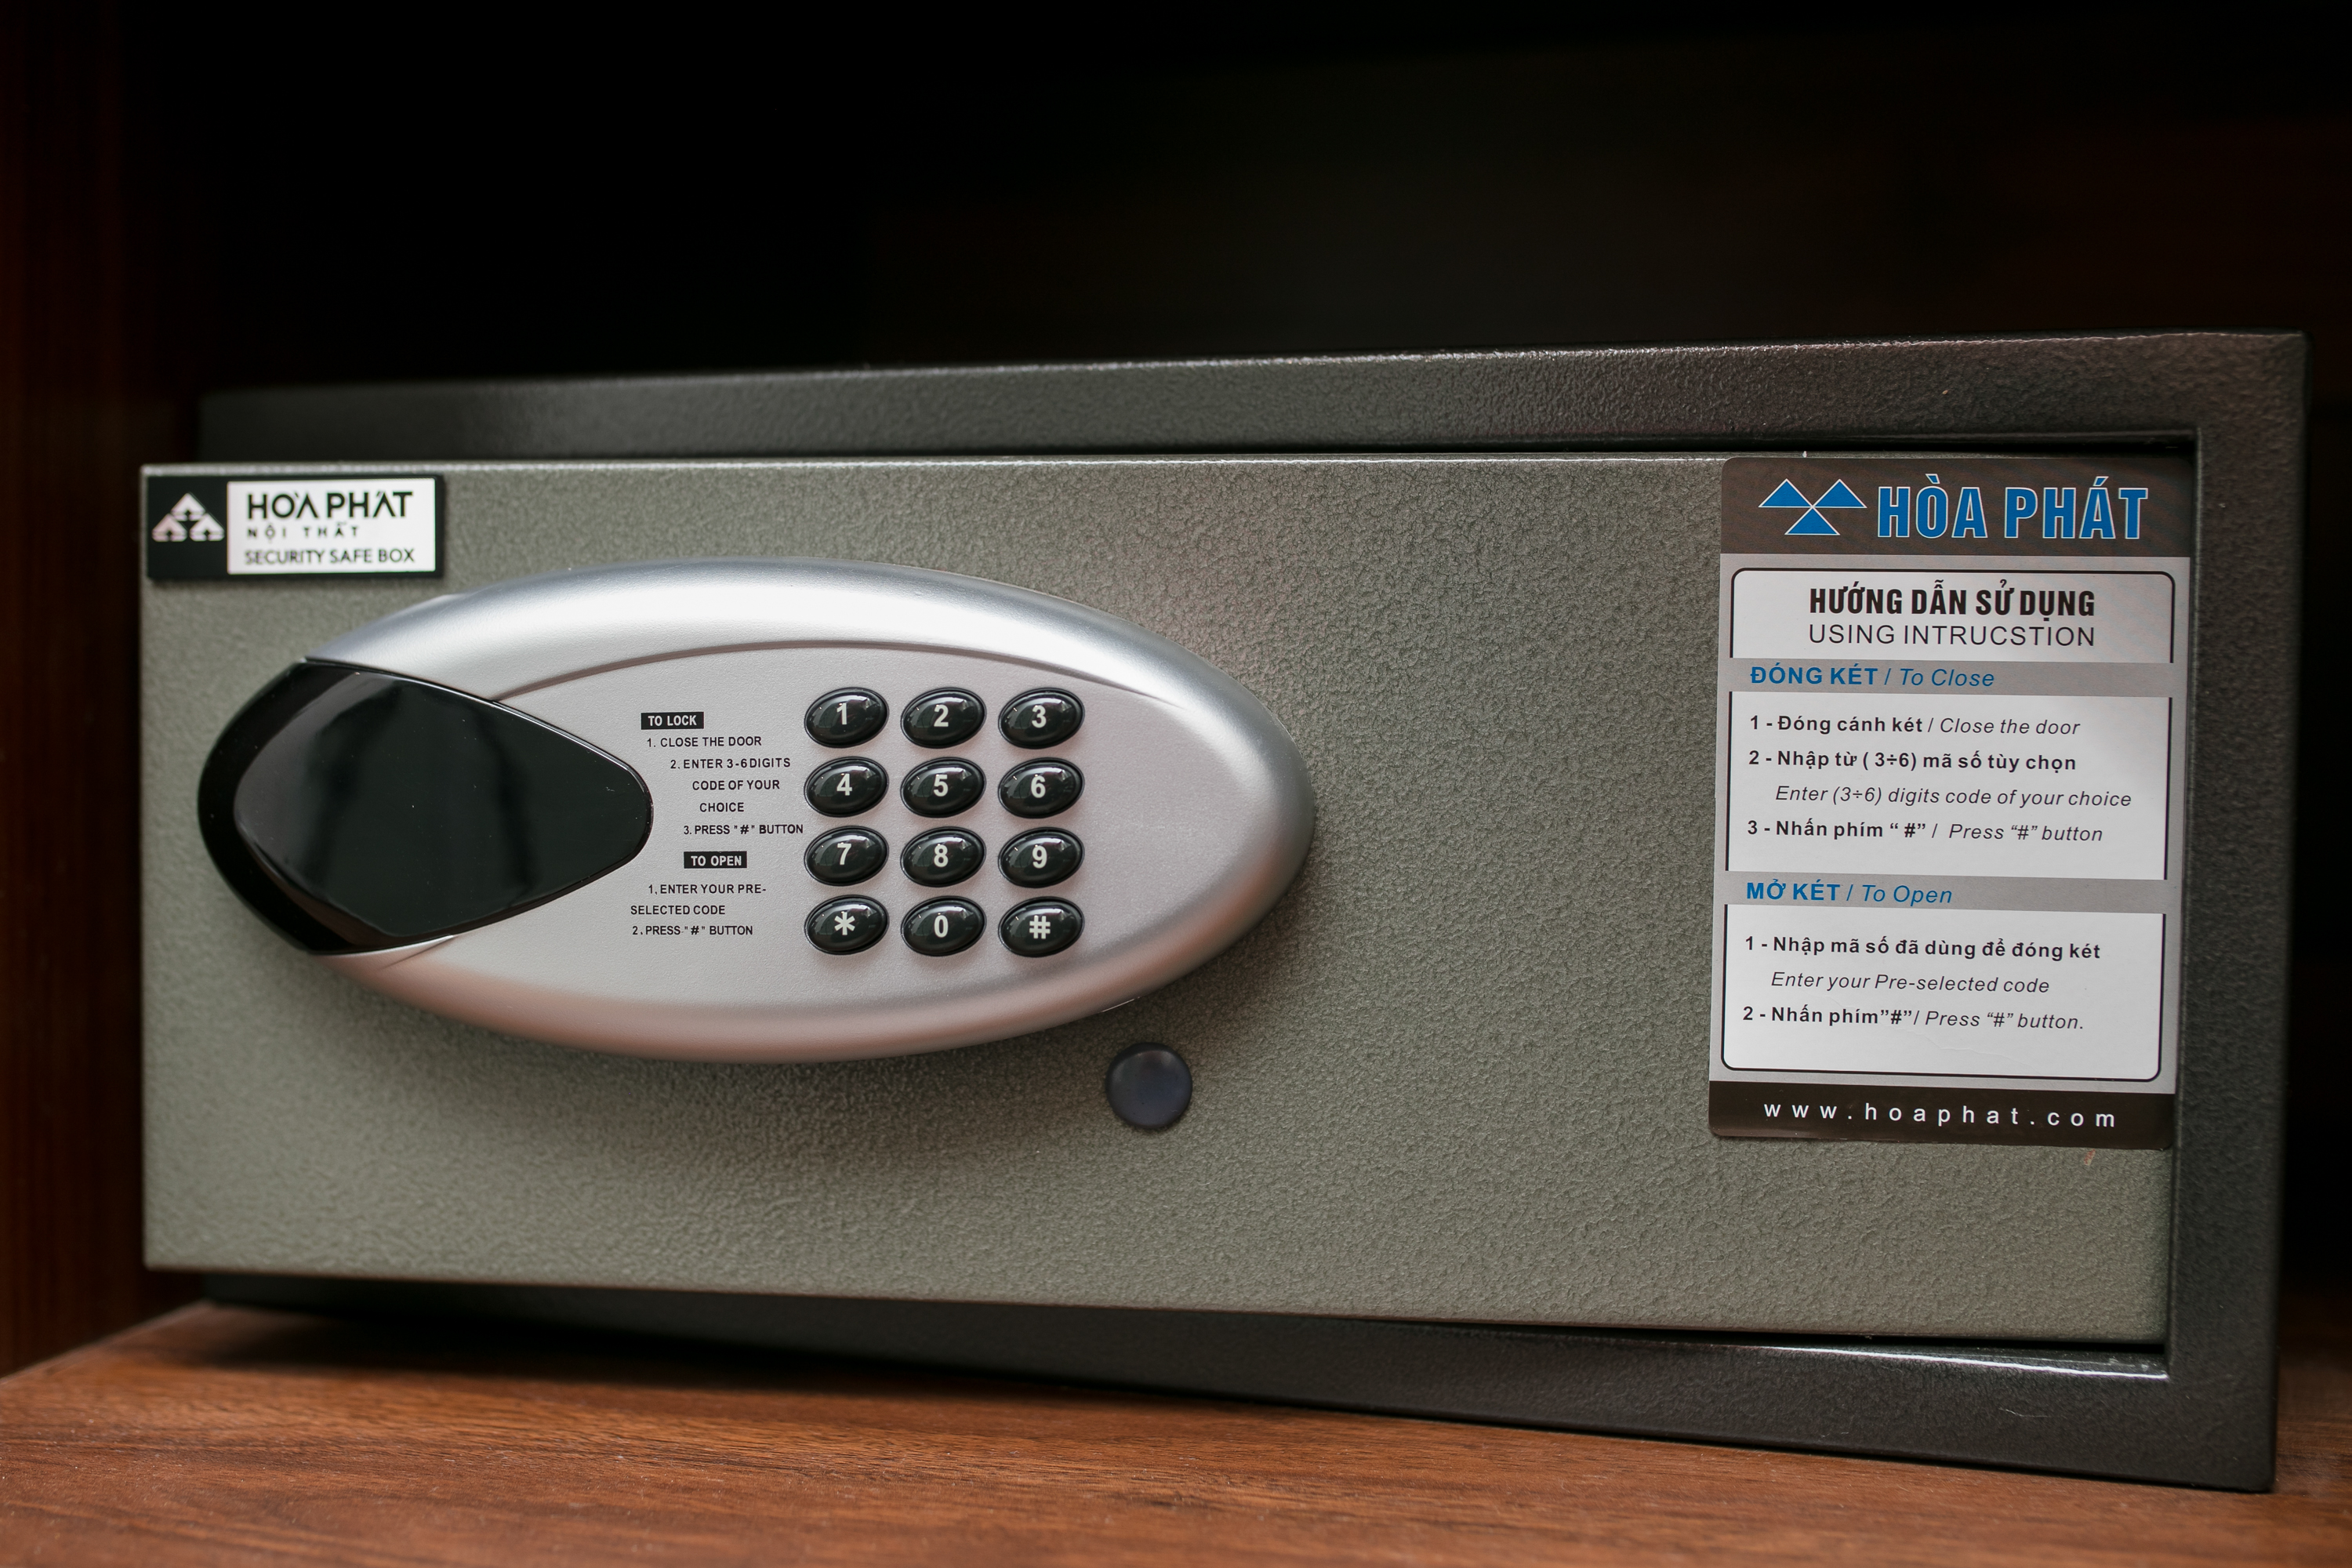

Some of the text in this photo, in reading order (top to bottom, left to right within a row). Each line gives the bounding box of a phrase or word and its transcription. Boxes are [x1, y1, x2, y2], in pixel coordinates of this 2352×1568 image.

[327, 492, 412, 517] PHÁT
[1878, 474, 2148, 539] HÒA PHÁT
[245, 549, 414, 564] SECURITY SAFE BOX
[1810, 579, 2094, 621] HƯỚNG DẪN SỬ DỤNG
[1810, 625, 2094, 646] USING INTRUCSTION
[1751, 662, 1822, 684] ĐÓNG
[1831, 663, 1878, 684] KÉT
[1900, 669, 1923, 685] To
[1932, 669, 1994, 686] Close
[648, 715, 696, 726] TO LOCK
[837, 702, 1047, 728] 1 2 3
[1751, 716, 1757, 729] 1
[1777, 716, 1830, 734] Đóng
[1838, 717, 1885, 731] cánh
[1893, 717, 1922, 732] két
[1940, 718, 1994, 733] Close
[2001, 719, 2029, 734] the
[2036, 720, 2080, 734] door
[661, 738, 698, 747] CLOSE
[702, 737, 724, 746] THE
[729, 736, 761, 746] DOOR
[684, 759, 722, 768] ENTER
[1749, 750, 1759, 764] 2
[1778, 751, 1828, 769] Nhập
[1835, 752, 1857, 766] từ
[1924, 753, 1951, 768] mã
[1958, 750, 1981, 768] số
[1988, 754, 2020, 772] tùy
[2026, 755, 2075, 773] chọn
[693, 780, 779, 790] CODE OF YOUR
[837, 774, 1046, 798] 4 5 6
[700, 803, 744, 812] CHOICE
[1776, 786, 1828, 800] Enter
[1889, 788, 1939, 806] digits
[1946, 789, 1991, 804] code
[1998, 789, 2017, 804] of
[2020, 794, 2063, 808] your
[2069, 791, 2131, 806] choice
[695, 825, 730, 834] PRESS
[760, 824, 803, 833] BUTTON
[1748, 820, 1757, 834] 3
[1777, 818, 1827, 836] Nhấn
[1835, 822, 1882, 840] phím
[1949, 824, 2004, 839] Press
[2042, 826, 2102, 840] button
[691, 855, 741, 866] TO OPEN
[837, 843, 1047, 869] 7 8 9
[661, 884, 697, 894] ENTER
[701, 884, 734, 894] YOUR
[739, 884, 766, 893] PRE-
[1748, 879, 1786, 899] MỞ
[1793, 879, 1840, 900] KÉT
[1863, 885, 1885, 902] To
[1893, 885, 1951, 906] Open
[631, 906, 725, 914] SELECTED CODE
[646, 926, 681, 935] PRESS
[710, 926, 753, 935] BUTTON
[934, 914, 949, 938] 0
[1746, 936, 1752, 950] 1
[1774, 937, 1824, 955] Nhập
[1831, 939, 1859, 953] mã
[1866, 936, 1889, 953] số
[1896, 940, 1918, 954] đã
[1926, 941, 1975, 959] dùng
[1983, 938, 2005, 956] để
[2013, 942, 2062, 961] đóng
[2071, 944, 2100, 958] két
[1772, 972, 2049, 993] Enter your Pre-selected code
[1744, 1007, 1752, 1020] 2
[1773, 1004, 1822, 1022] Nhấn
[1926, 1011, 1980, 1026] Press
[2018, 1014, 2082, 1029] button.
